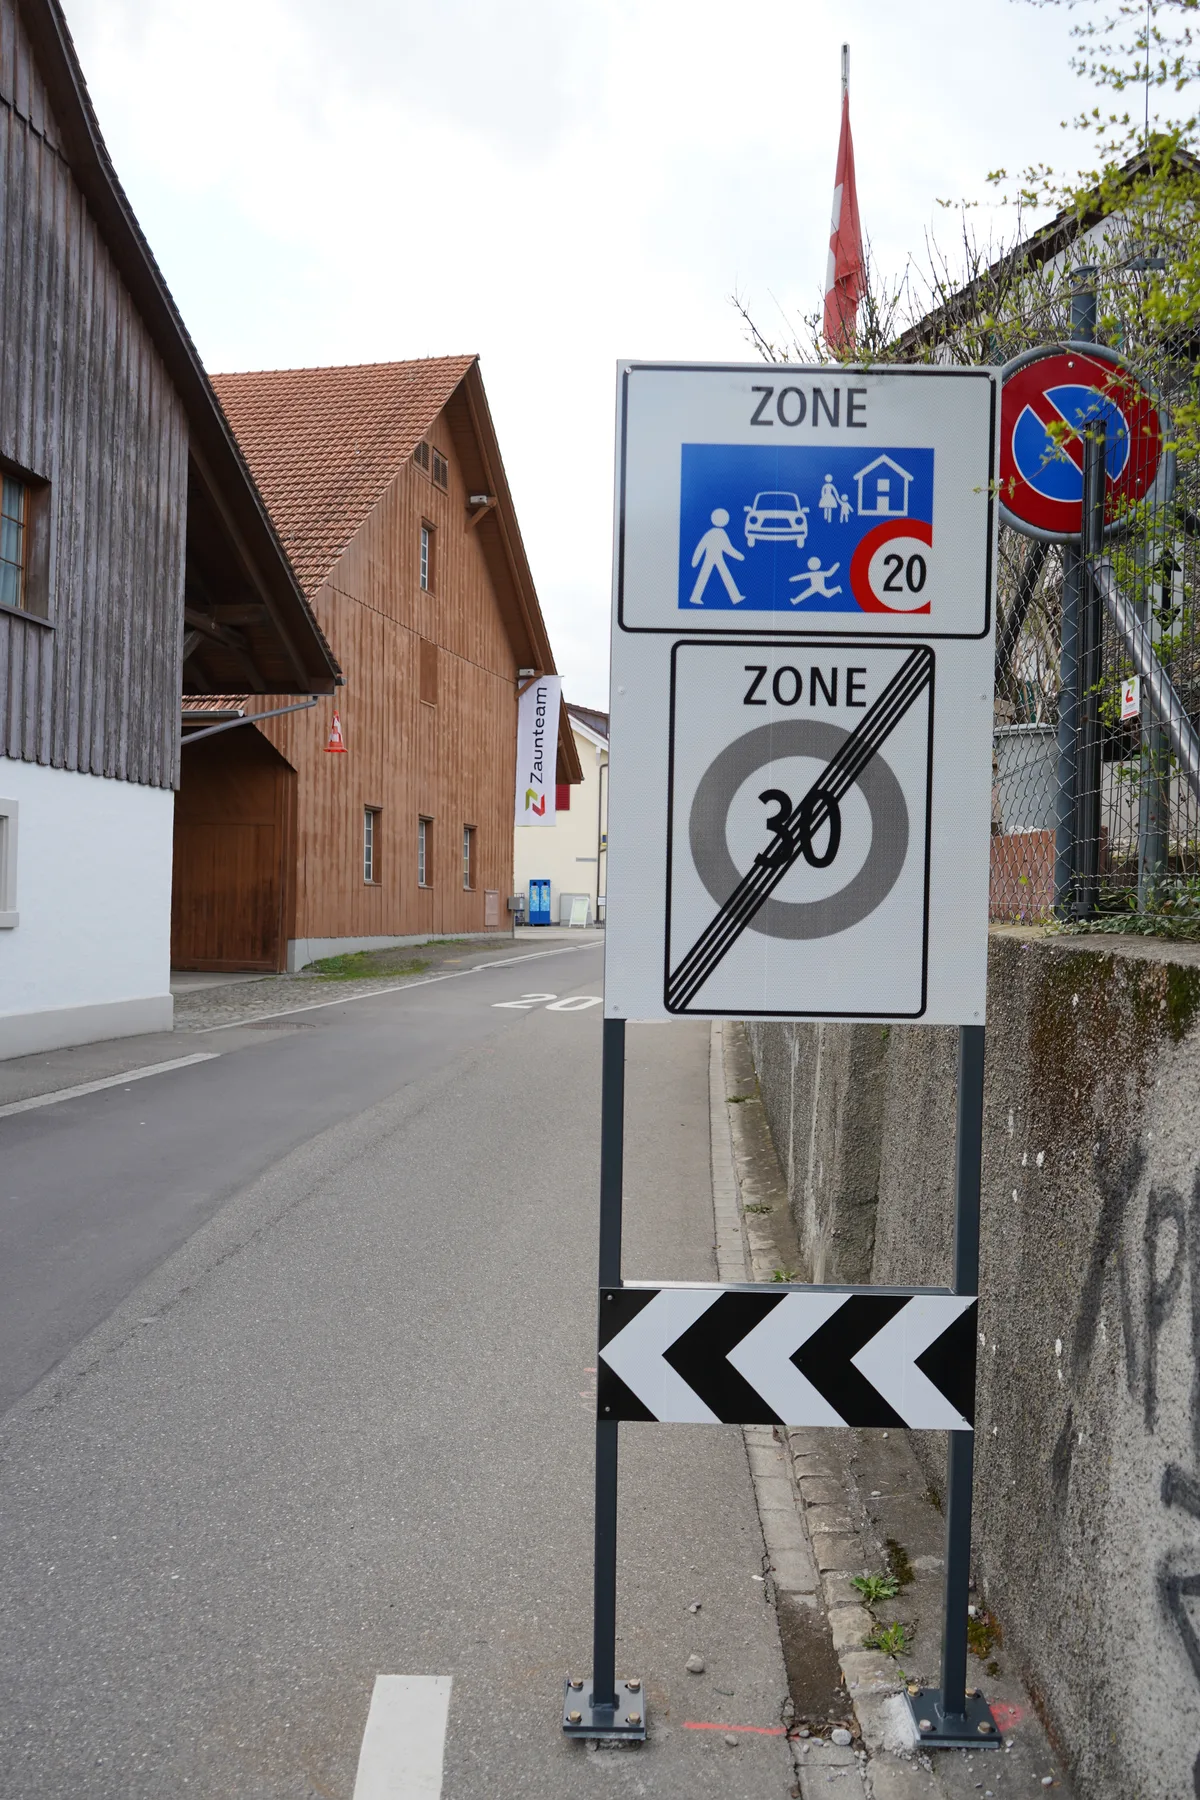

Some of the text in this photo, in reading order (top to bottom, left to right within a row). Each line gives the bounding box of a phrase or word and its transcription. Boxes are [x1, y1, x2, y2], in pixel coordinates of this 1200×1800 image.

[750, 386, 868, 429] ZONE
[882, 553, 927, 593] 20
[743, 665, 867, 708] ZONE
[530, 687, 548, 784] Zaunteam
[755, 788, 842, 869] 30
[491, 993, 604, 1012] 20
